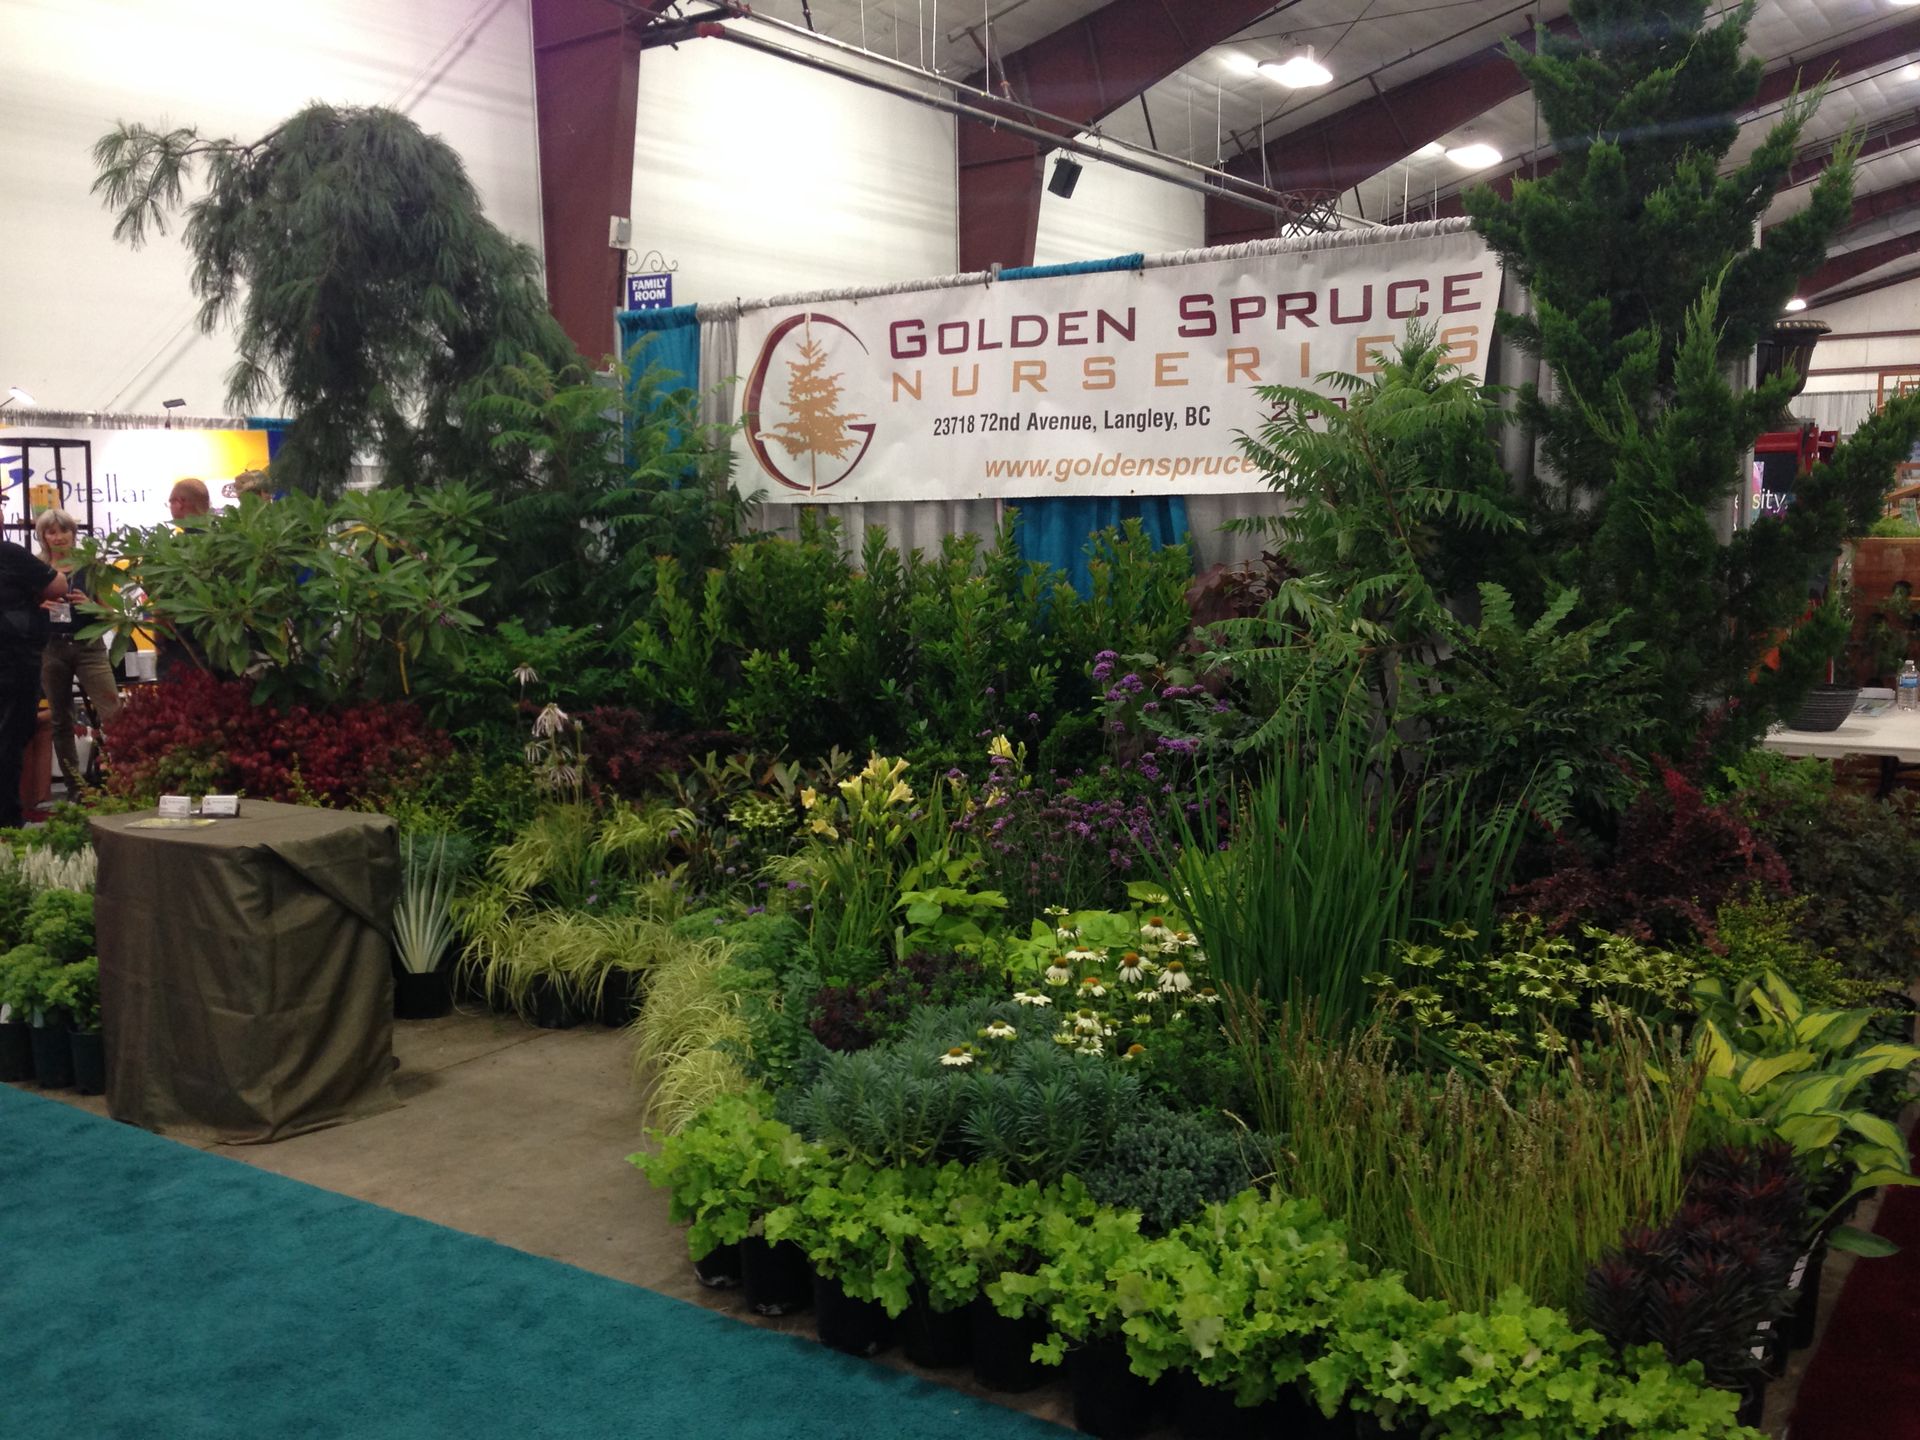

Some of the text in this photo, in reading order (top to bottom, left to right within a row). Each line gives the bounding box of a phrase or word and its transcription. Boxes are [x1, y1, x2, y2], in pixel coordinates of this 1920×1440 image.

[632, 278, 668, 290] FAMILY
[634, 290, 666, 301] ROOM
[889, 271, 1483, 359] GOLDEN SPRUCE
[892, 325, 1479, 402] NURSERIES
[933, 405, 1212, 436] 23718 72nd Avenue, Langley, BC
[985, 452, 1258, 482] www.goldenspruce
[44, 467, 150, 505] Stellar
